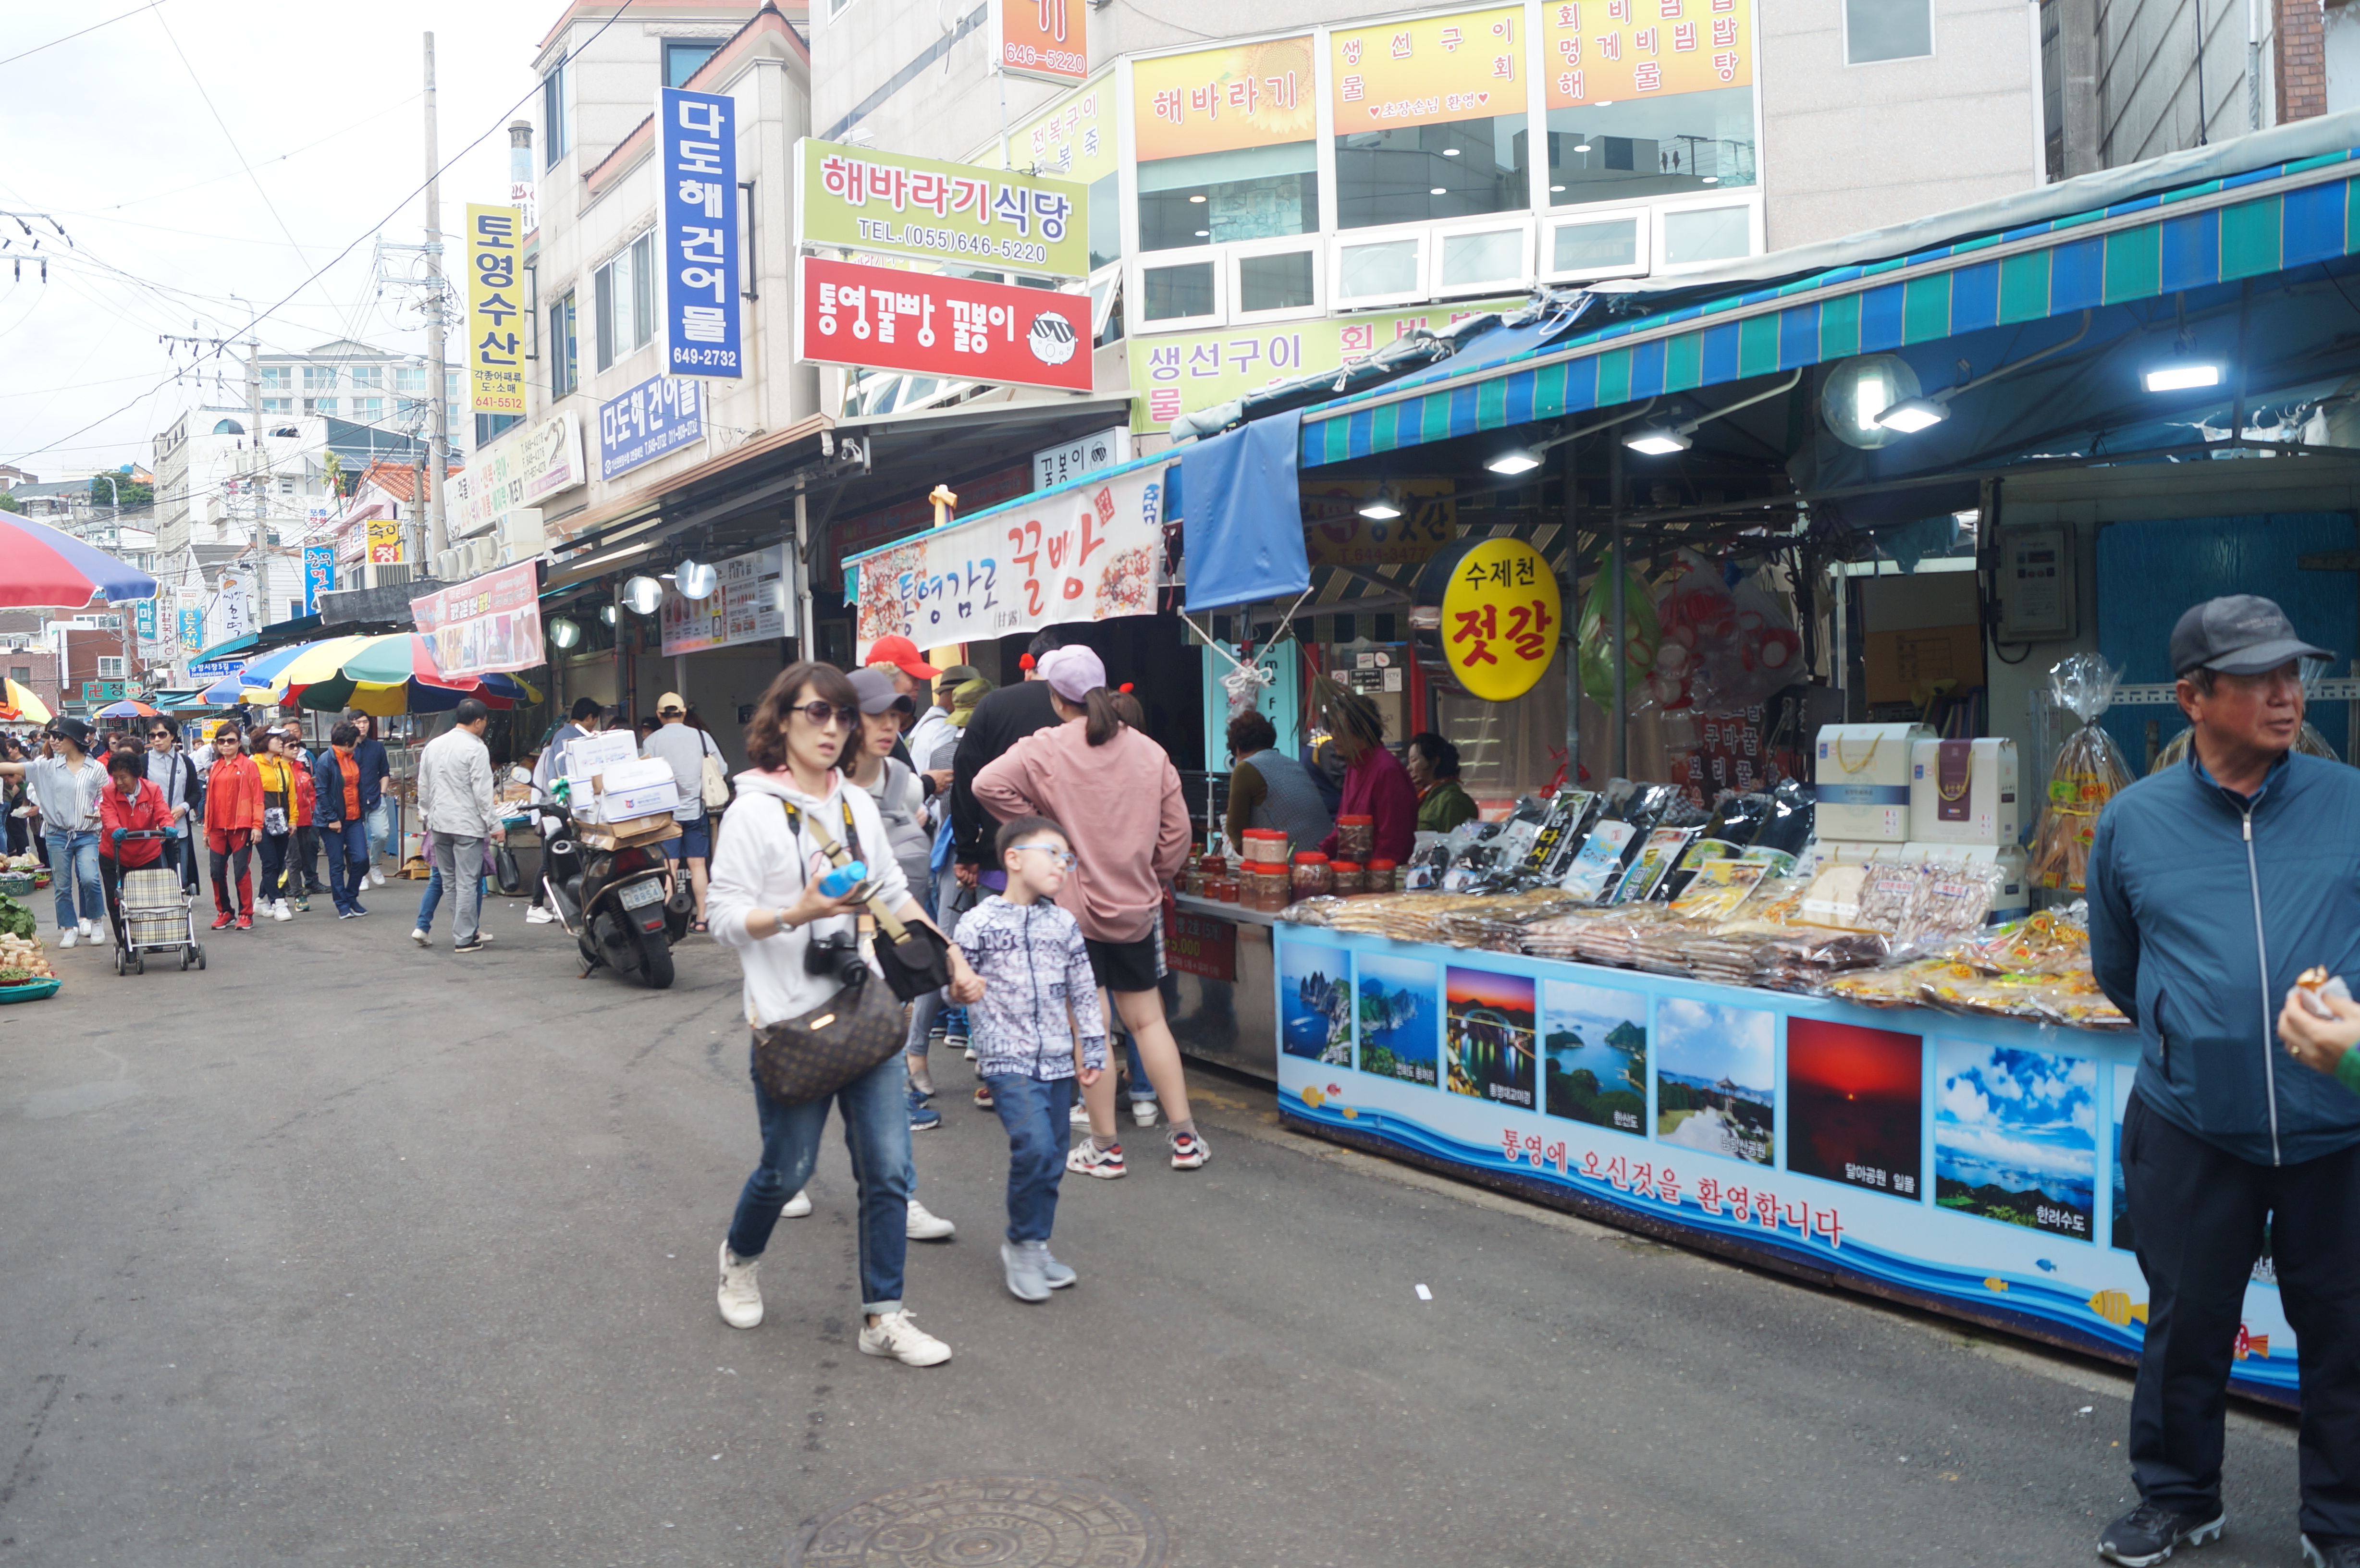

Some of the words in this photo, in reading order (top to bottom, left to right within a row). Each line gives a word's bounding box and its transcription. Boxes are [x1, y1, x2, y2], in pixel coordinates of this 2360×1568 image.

[1005, 43, 1085, 73] 646-5220
[1559, 17, 1738, 65] 멍게비빔밥
[1558, 52, 1738, 98] 해물탕
[1154, 72, 1296, 123] 해바라기
[1383, 98, 1438, 118] 초장손님
[1447, 93, 1475, 110] 환영
[1033, 94, 1096, 154] 전복구이
[823, 157, 1070, 240] 해바라기식당
[476, 215, 520, 366] 토영수산
[819, 283, 934, 347] 통영꿀빵
[946, 299, 1014, 354] 꿀봉이
[474, 370, 522, 382] 각종어패류
[674, 347, 737, 367] 649-2732
[1149, 335, 1300, 380] 생선구이
[476, 395, 522, 409] 641-5512
[604, 390, 645, 450] 다도해
[482, 464, 493, 489] 전복
[495, 455, 507, 482] 장어
[898, 558, 998, 637] 통영감로
[1009, 513, 1105, 616] 꿀빵
[1464, 556, 1535, 590] 수제천
[161, 613, 172, 645] 칼국수
[1453, 599, 1553, 668] 젓갈
[1529, 829, 1559, 870] 다시
[1613, 1110, 1638, 1128] 한산도
[1721, 1135, 1766, 1158] 남망산공원
[1501, 1129, 1567, 1174] 통영에
[1581, 1151, 1681, 1204] 오신것을
[1697, 1177, 1844, 1248] 환영합니다
[1845, 1163, 1886, 1186] 달아공원
[1893, 1173, 1915, 1193] 일몰
[2036, 1204, 2085, 1231] 한려수도
